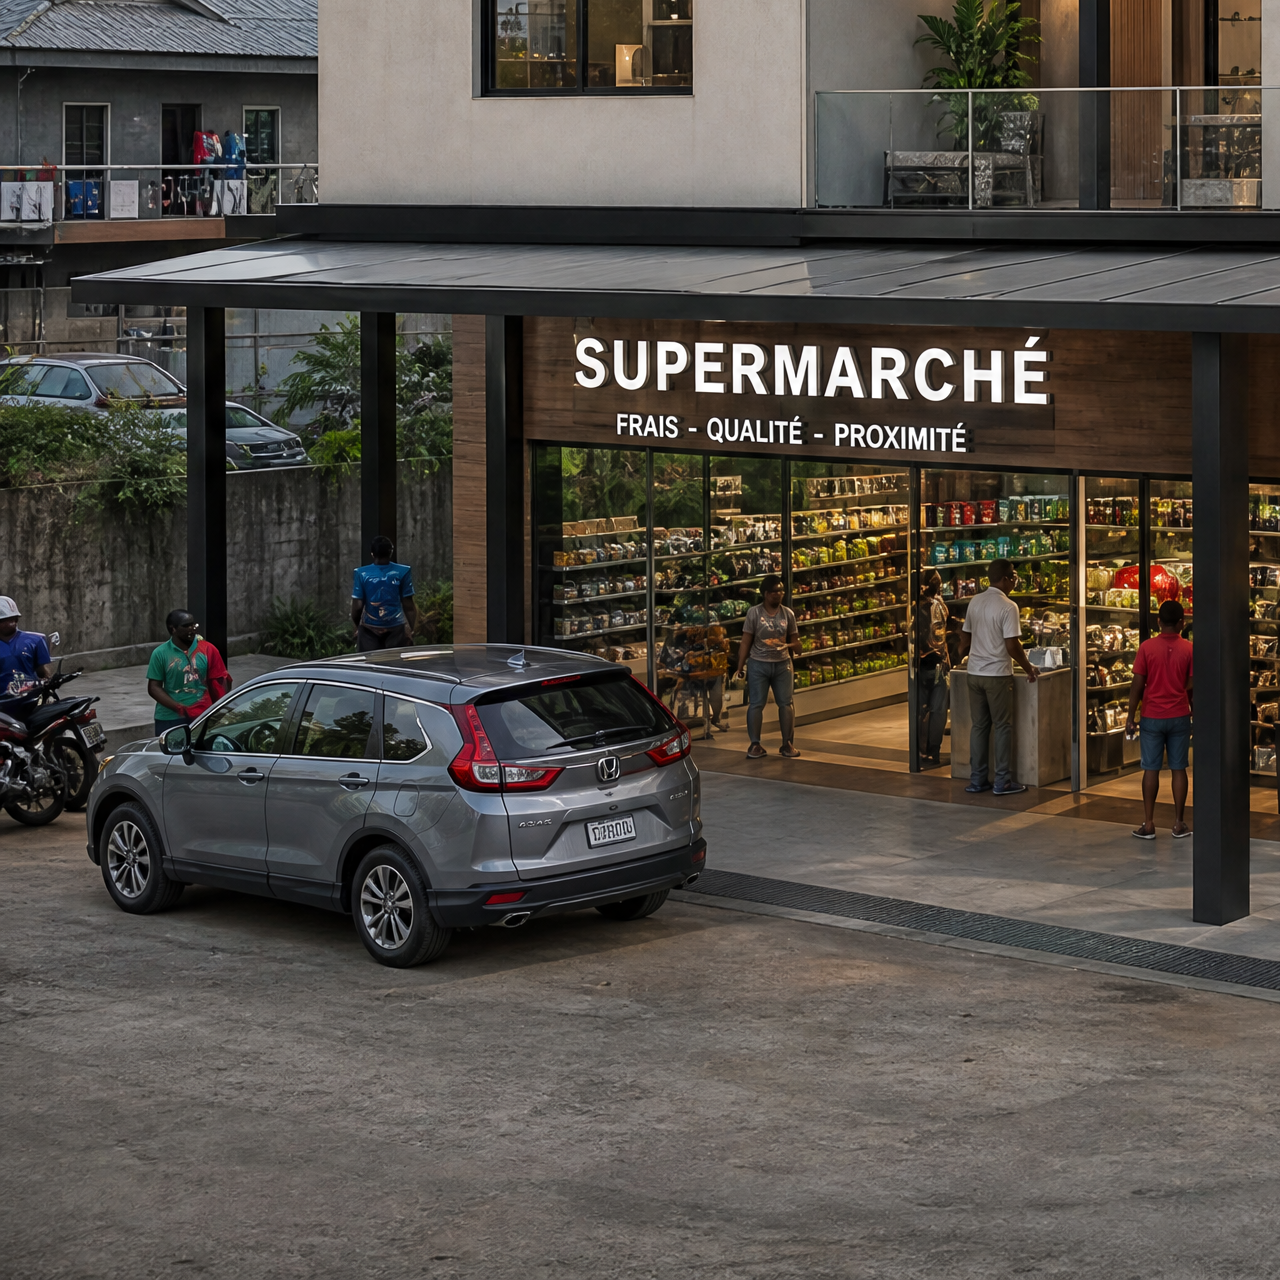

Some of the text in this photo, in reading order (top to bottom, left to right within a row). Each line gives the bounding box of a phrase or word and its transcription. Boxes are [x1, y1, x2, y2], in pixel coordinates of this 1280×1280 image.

[575, 335, 1049, 405] SUPERMARCHÉ
[616, 413, 679, 439] FRAIS
[706, 415, 803, 445] QUALITÉ
[834, 422, 967, 453] PROXIMITÉ
